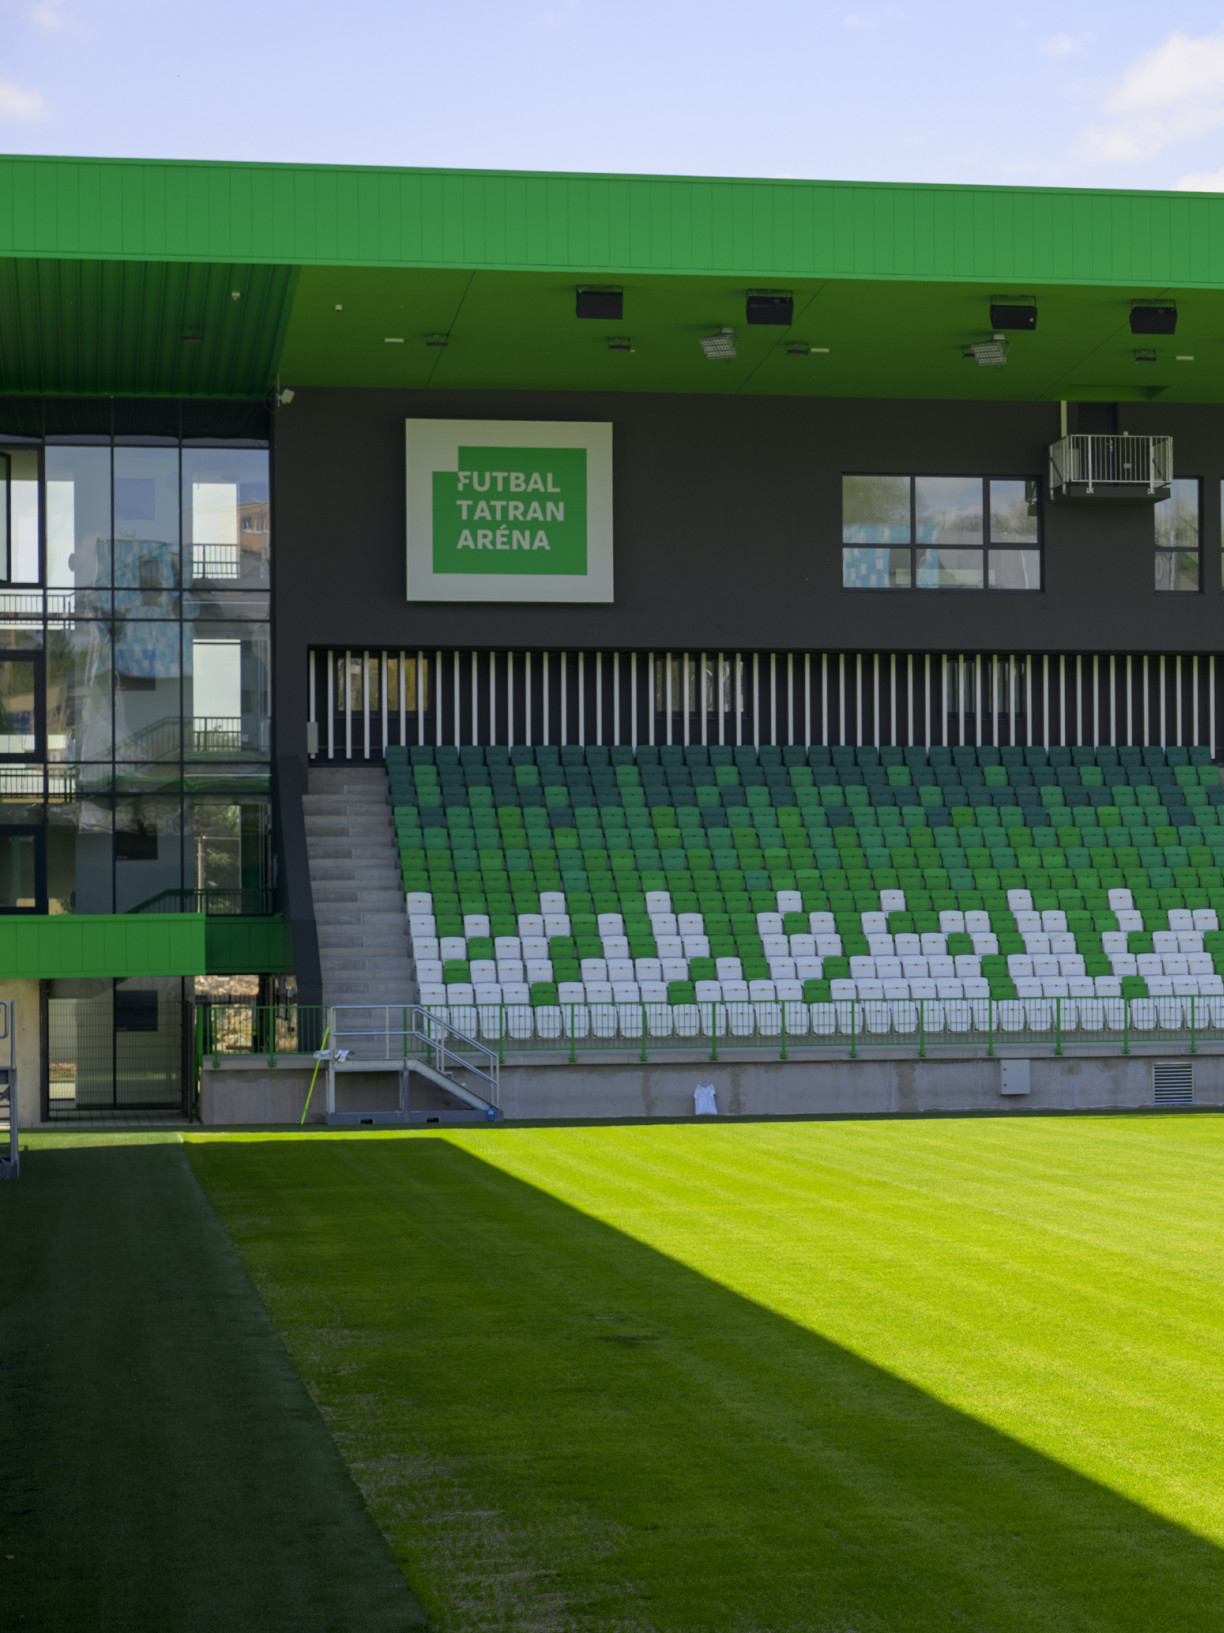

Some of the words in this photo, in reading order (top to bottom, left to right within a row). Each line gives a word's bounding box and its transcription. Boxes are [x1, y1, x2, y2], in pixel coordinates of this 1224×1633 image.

[457, 471, 561, 493] FUTBAL
[456, 500, 564, 522] TATRAN
[456, 523, 551, 551] ARÉNA
